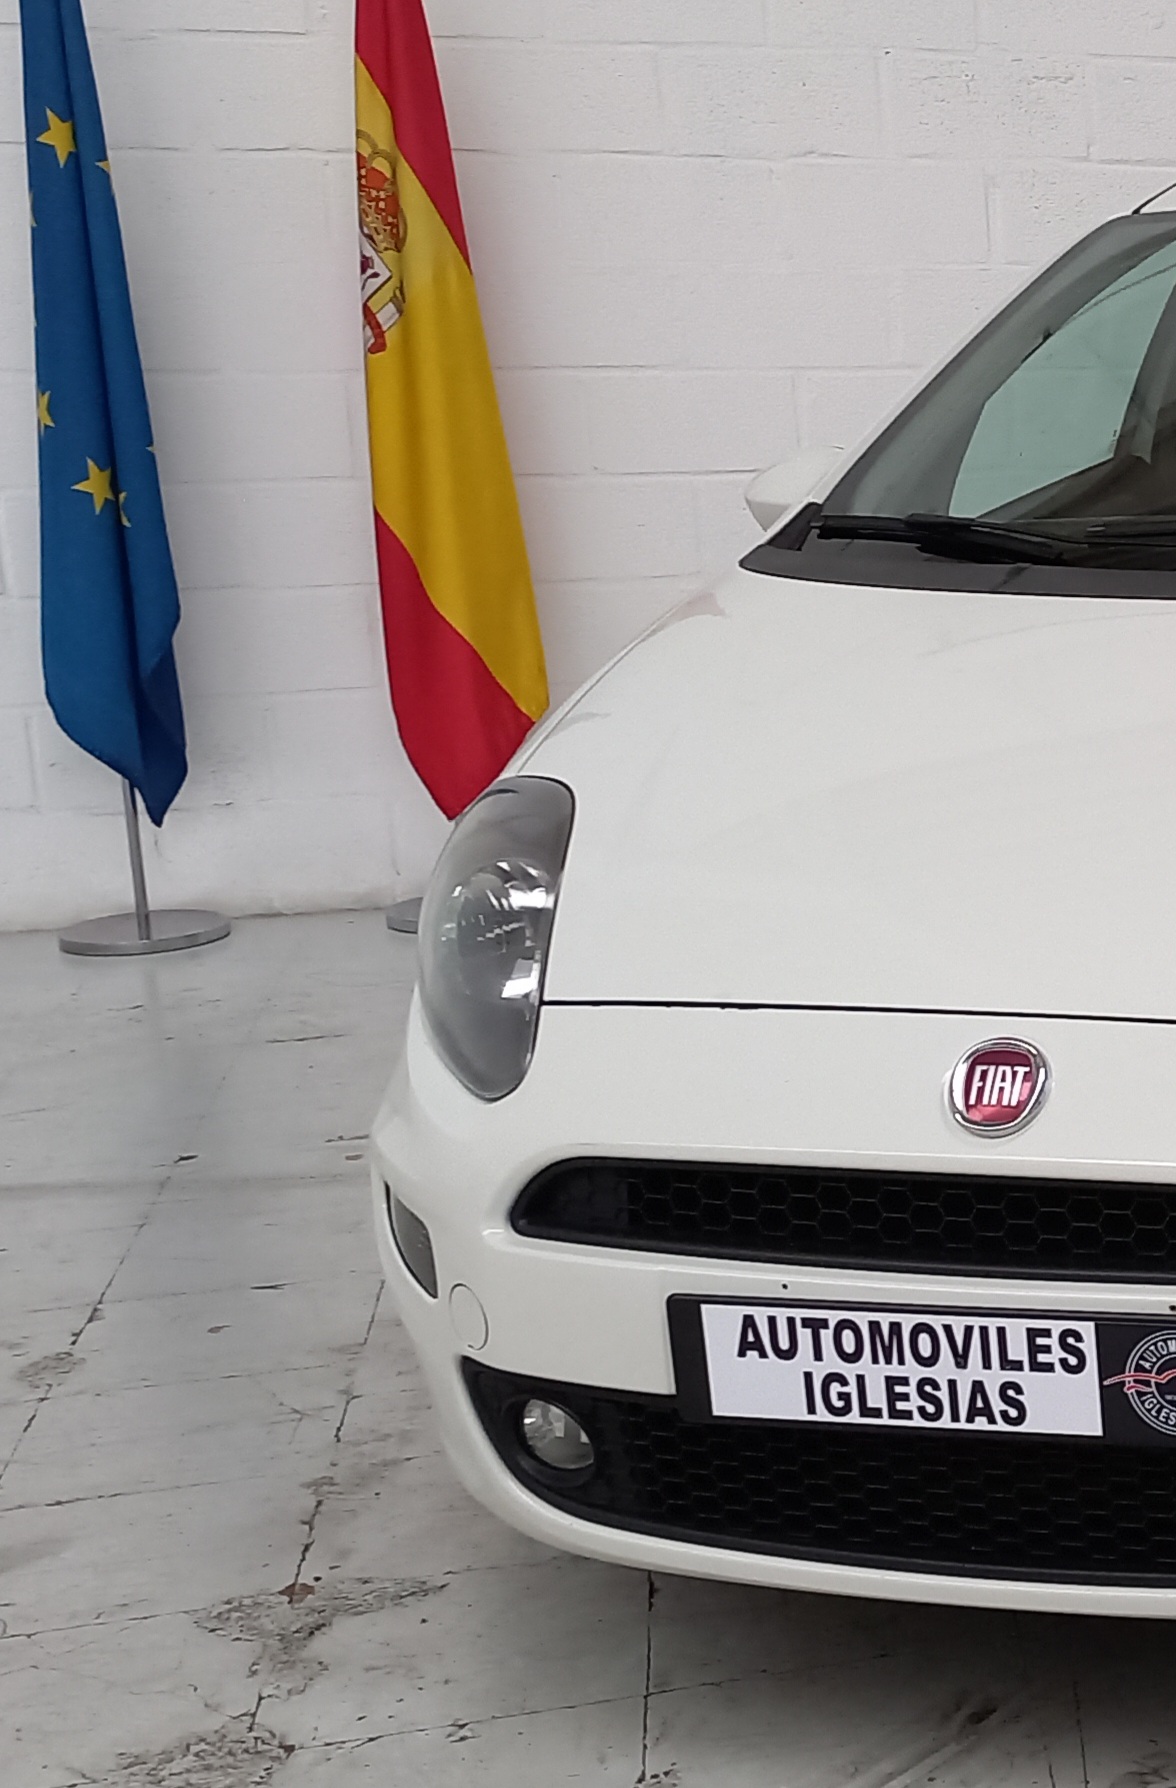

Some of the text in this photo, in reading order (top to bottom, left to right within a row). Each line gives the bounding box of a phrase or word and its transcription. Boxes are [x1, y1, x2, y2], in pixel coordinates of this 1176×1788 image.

[969, 1065, 1030, 1107] FIAT
[736, 1314, 1088, 1375] AUTOMOVILES
[803, 1371, 1028, 1427] IGLESIAS
